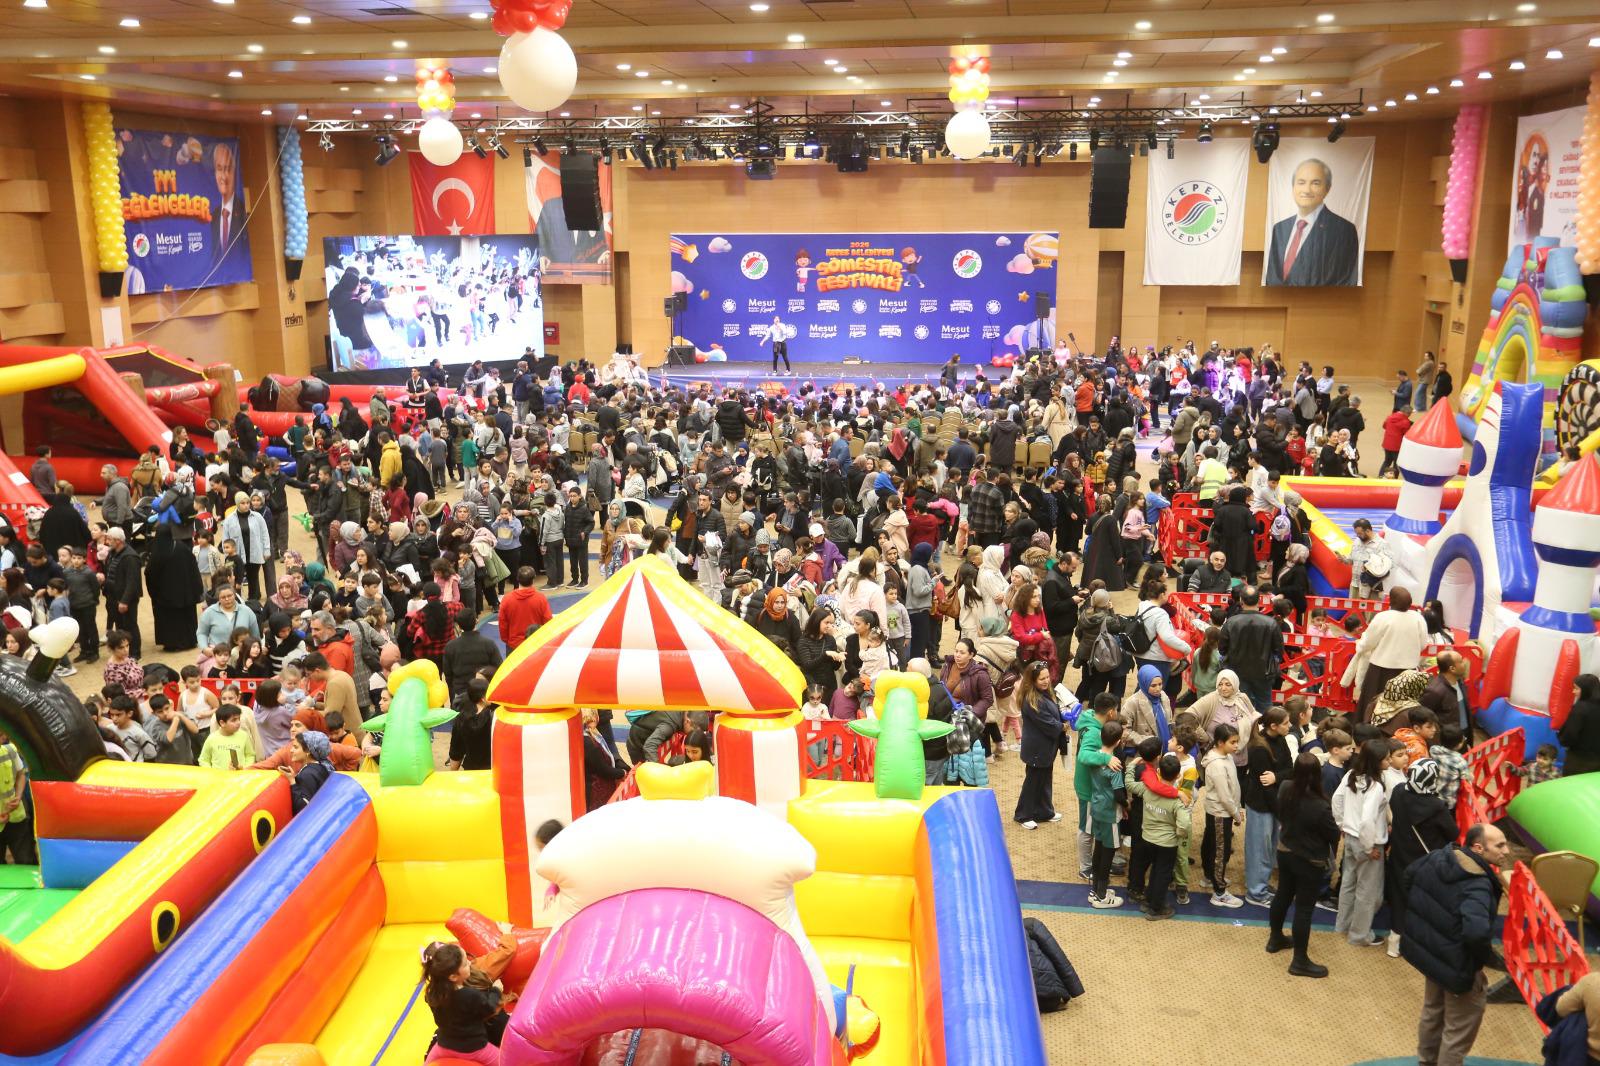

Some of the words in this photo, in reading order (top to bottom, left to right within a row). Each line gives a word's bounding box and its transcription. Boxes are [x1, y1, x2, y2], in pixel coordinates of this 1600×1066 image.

[1168, 183, 1222, 206] KEPEZ
[156, 233, 183, 245] Mesut
[816, 257, 903, 279] SÖMESTİR
[816, 273, 904, 292] FESTİVALİ
[748, 298, 776, 307] Mesut
[879, 299, 908, 307] Mesut
[809, 324, 838, 332] Mesut
[941, 325, 970, 333] Mesut
